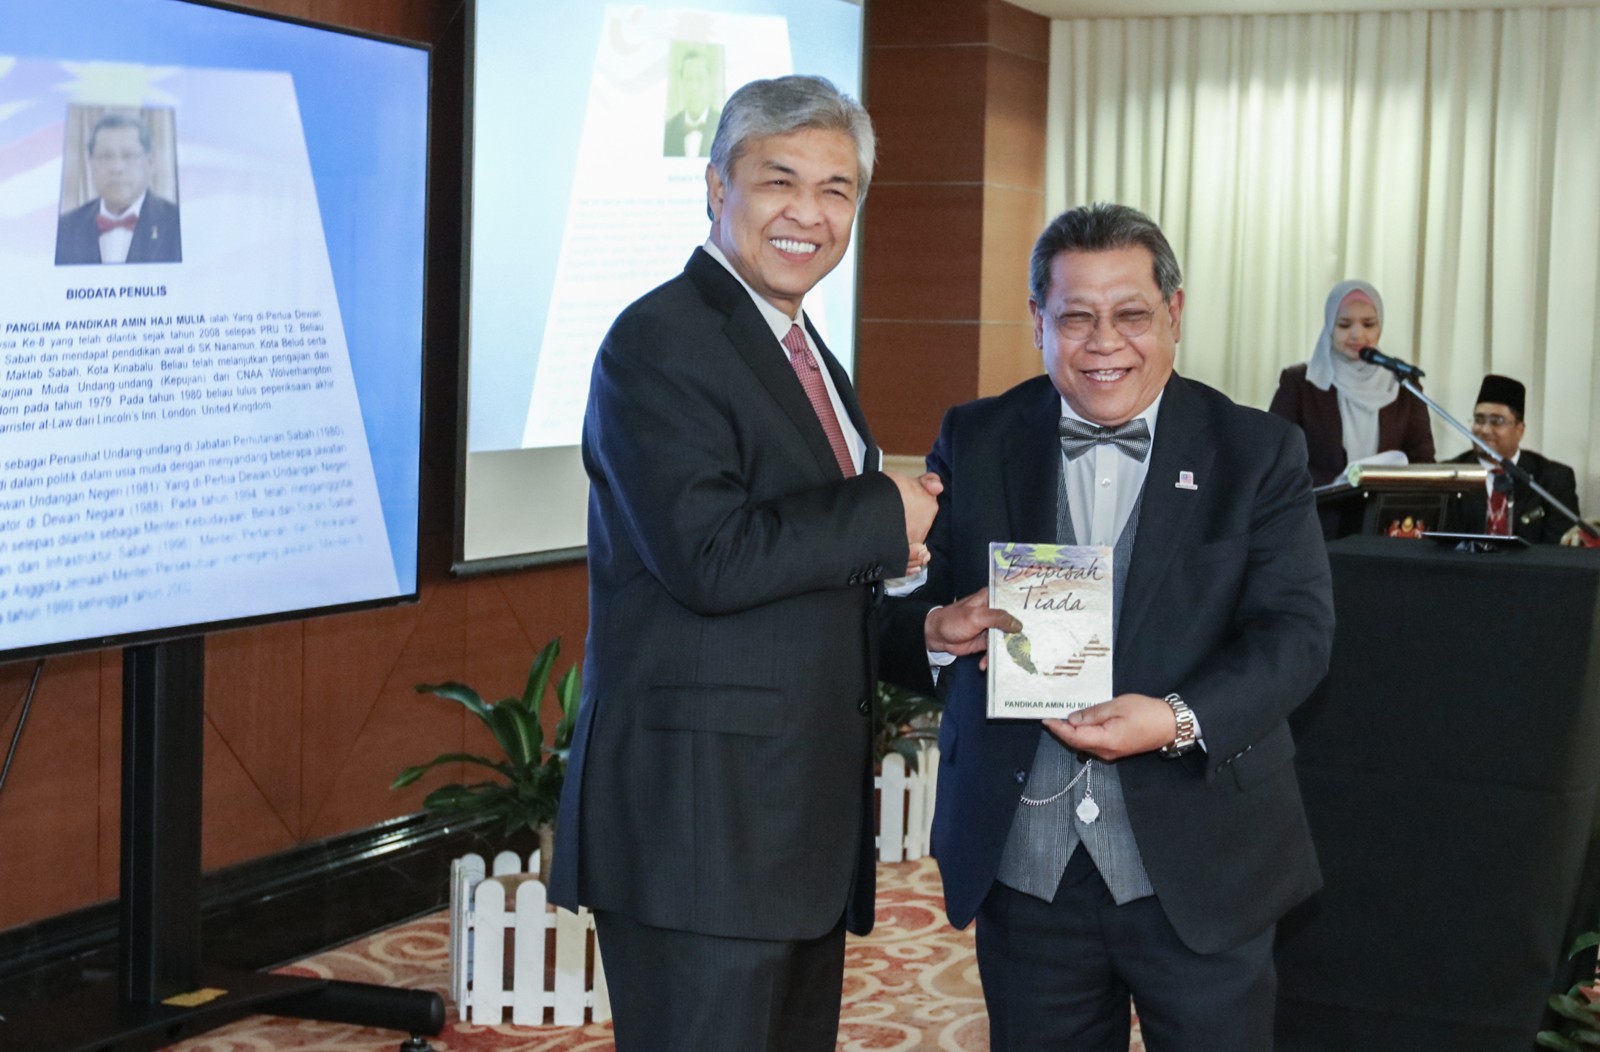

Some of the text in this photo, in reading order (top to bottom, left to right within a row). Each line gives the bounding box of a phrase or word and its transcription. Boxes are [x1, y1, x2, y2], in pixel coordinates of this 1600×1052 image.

[66, 286, 166, 300] BIODATA PENULIS
[6, 322, 60, 333] PANGLIMA
[66, 318, 117, 330] PANDIKAR
[122, 317, 146, 327] AMIN
[151, 316, 172, 326] HAJI
[177, 315, 205, 324] MULIA
[210, 312, 229, 323] ialah
[233, 312, 253, 323] Yang
[295, 309, 321, 318] Dewan
[51, 337, 73, 348] yang
[79, 336, 101, 344] telah
[107, 332, 137, 343] dilantik
[143, 332, 165, 342] sejak
[171, 330, 194, 339] tahun
[200, 328, 220, 338] 2008
[225, 326, 256, 337] selepas
[261, 324, 279, 334] PRU
[300, 323, 324, 332] Beliau
[5, 353, 36, 365] Sabah
[40, 353, 58, 363] dan
[62, 350, 108, 361] mendapat
[112, 347, 160, 359] pendidikan
[164, 345, 184, 355] awal
[188, 344, 195, 353] di
[199, 342, 211, 352] SK
[260, 339, 278, 348] Kota
[282, 337, 304, 347] Belud
[307, 336, 326, 346] serta
[6, 368, 42, 381] Maktab
[87, 365, 108, 375] Kota
[161, 360, 188, 370] Beliau
[193, 358, 213, 368] telah
[218, 355, 268, 367] melanjutkan
[272, 352, 310, 363] pengajian
[314, 350, 329, 360] dan
[42, 384, 69, 395] Muda
[237, 369, 263, 380] CNAA
[270, 365, 332, 378] Wolverhampton
[24, 402, 49, 416] pada
[55, 400, 82, 411] tahun
[120, 394, 144, 405] Pada
[149, 391, 174, 404] tahun
[180, 389, 201, 400] 1980
[207, 388, 232, 398] beliau
[237, 386, 256, 396] lulus
[261, 382, 311, 395] peperiksaan
[202, 404, 230, 415] United
[5, 458, 46, 471] sebagai
[49, 451, 100, 466] Penasihat
[103, 443, 181, 460] Undang-undang
[196, 438, 231, 450] Jabatan
[287, 429, 314, 441] Sabah
[10, 476, 43, 490] dalam
[47, 473, 76, 488] politik
[80, 468, 112, 482] dalam
[115, 466, 136, 477] usia
[139, 462, 166, 474] muda
[170, 460, 205, 472] dengan
[208, 453, 268, 467] menyandang
[270, 447, 311, 460] beberapa
[30, 491, 85, 508] Undangan
[166, 479, 189, 491] Yang
[239, 470, 271, 482] Dewan
[42, 512, 80, 528] Dewan
[86, 507, 124, 521] Negara
[1003, 554, 1104, 585] Berpisah
[1019, 585, 1086, 611] Tiada
